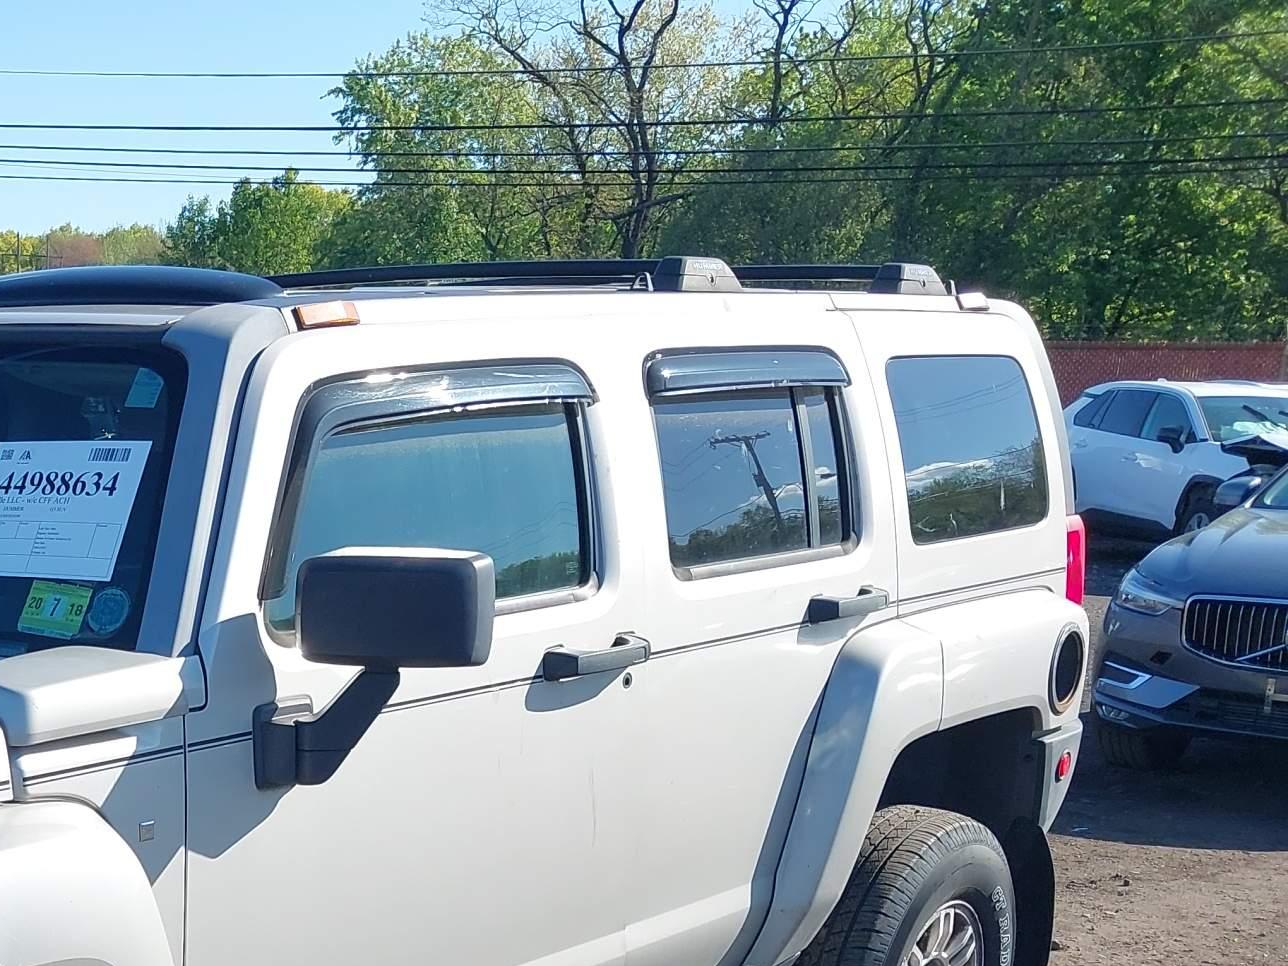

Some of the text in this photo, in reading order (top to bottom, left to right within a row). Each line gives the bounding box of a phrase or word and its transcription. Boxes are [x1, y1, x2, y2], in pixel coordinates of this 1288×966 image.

[6, 496, 22, 504] LLC
[27, 597, 84, 617] 20 7 18
[991, 886, 1007, 912] GT
